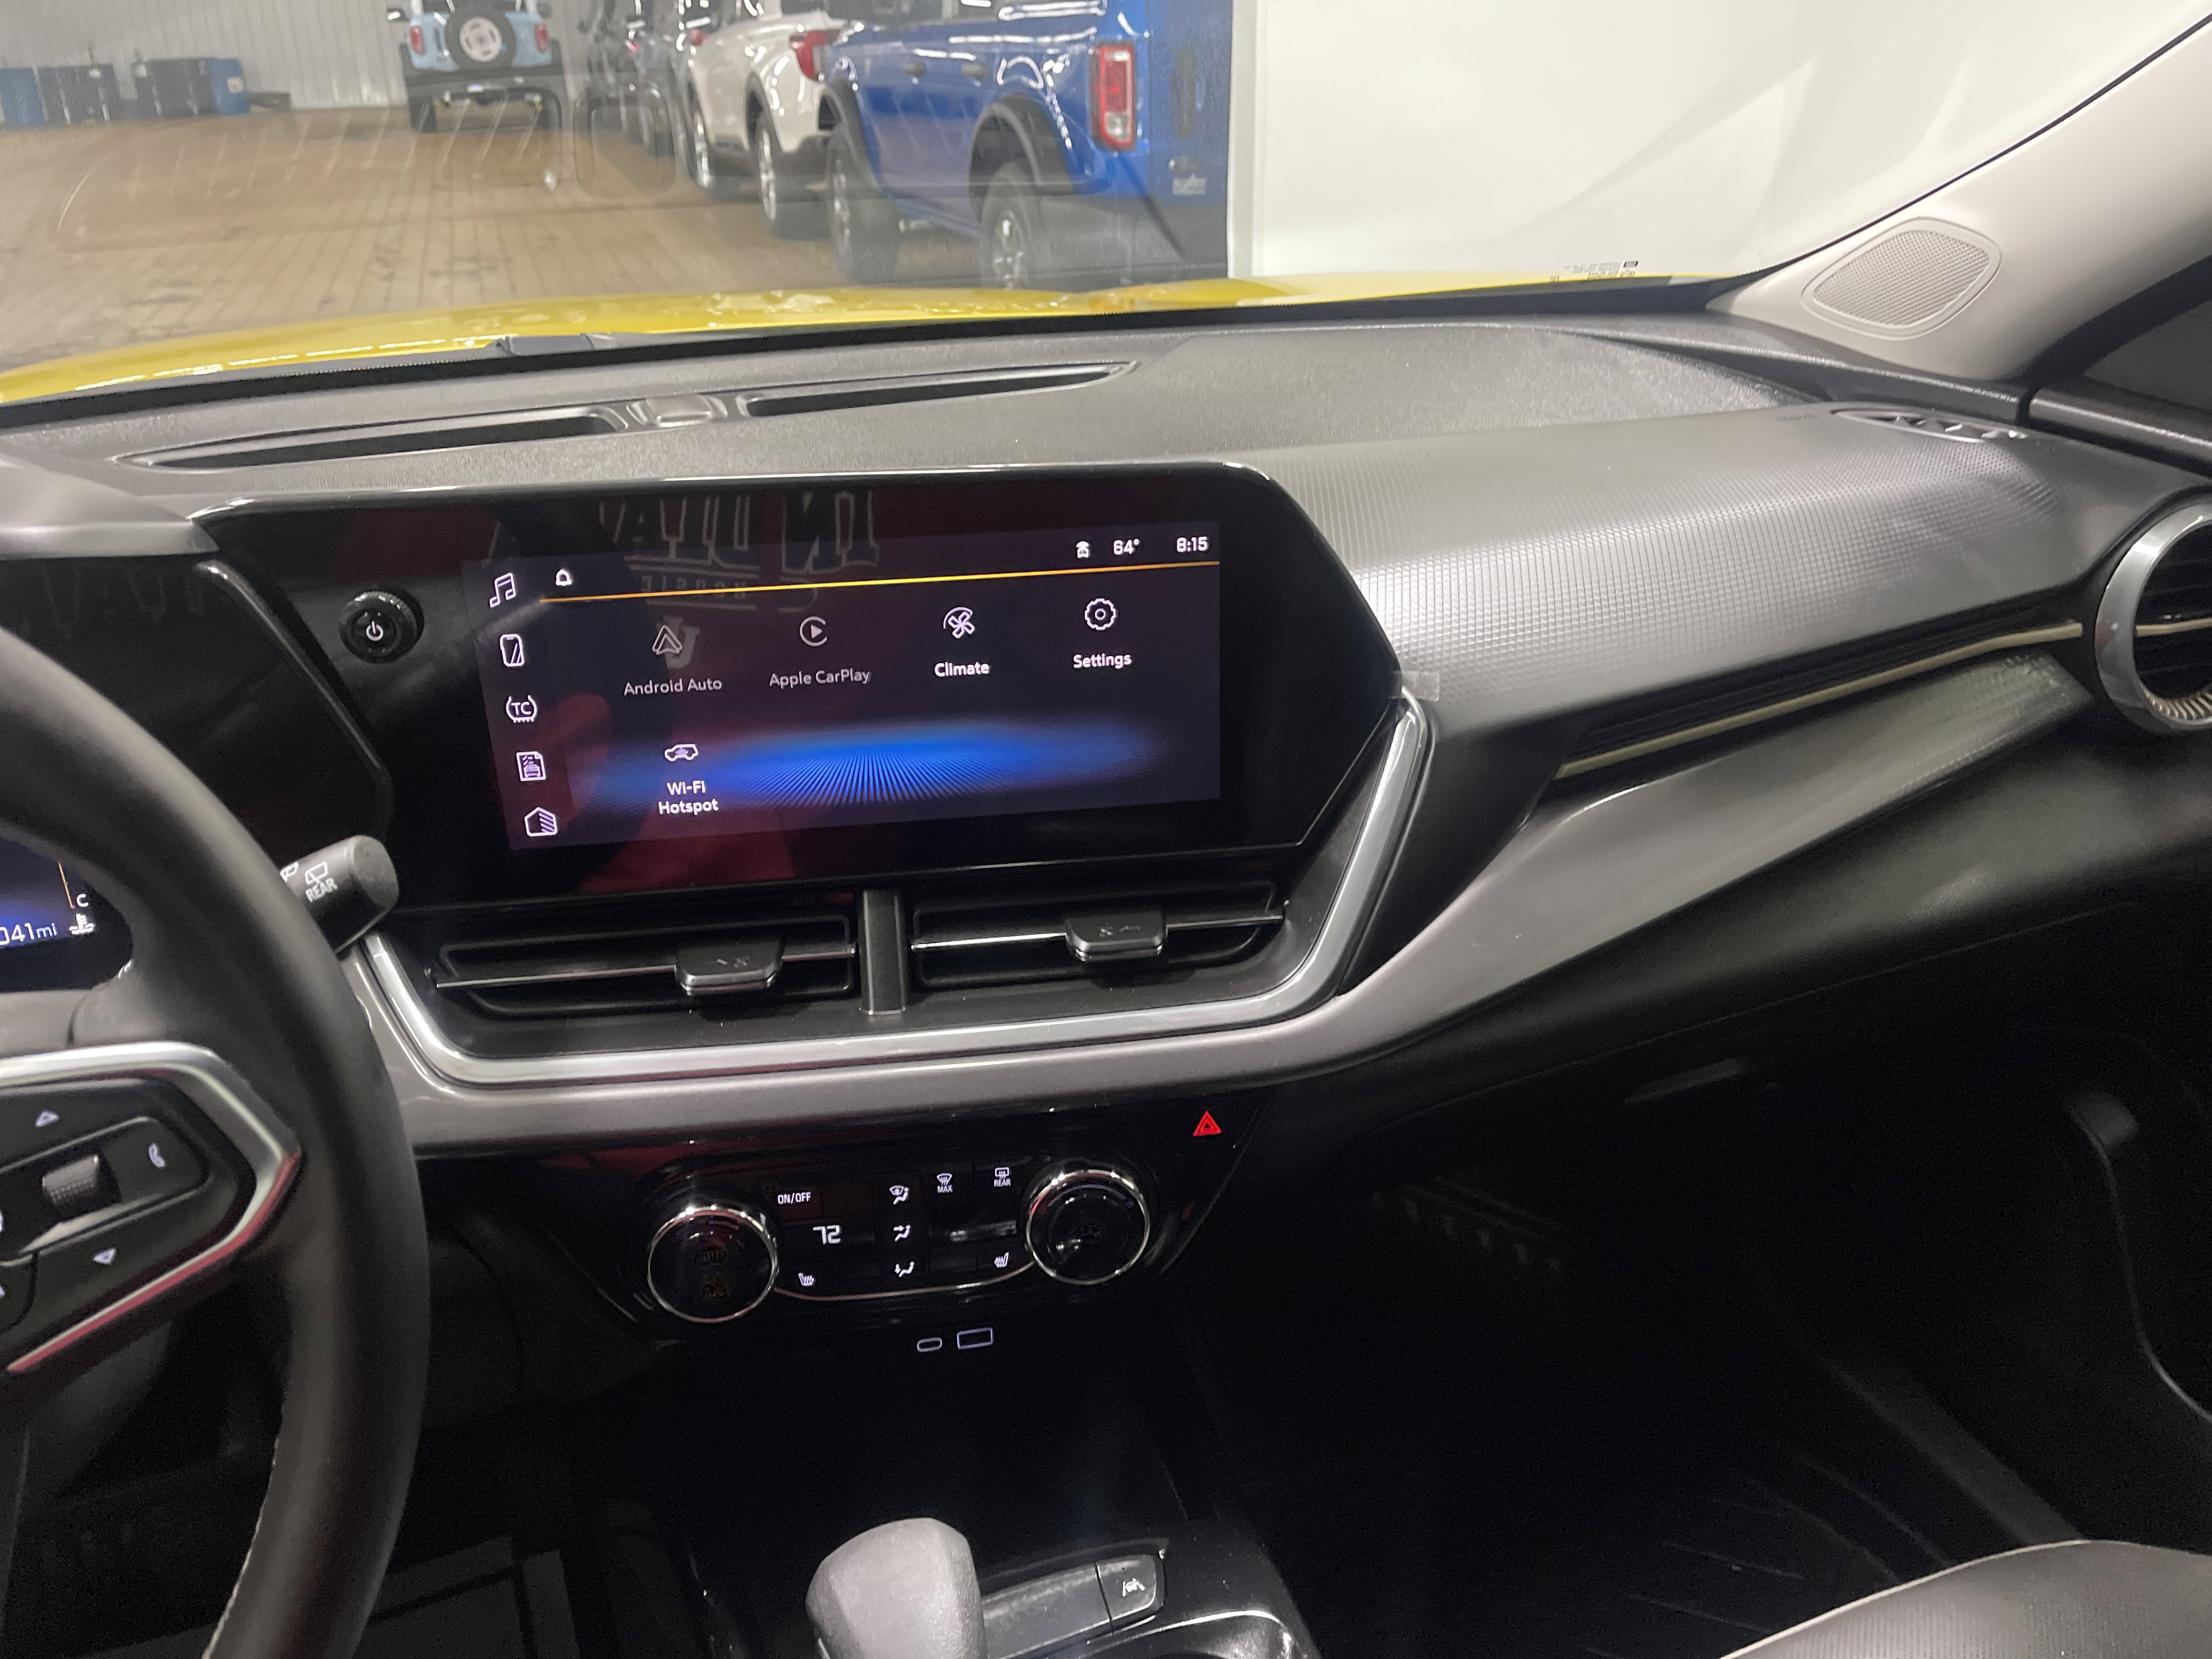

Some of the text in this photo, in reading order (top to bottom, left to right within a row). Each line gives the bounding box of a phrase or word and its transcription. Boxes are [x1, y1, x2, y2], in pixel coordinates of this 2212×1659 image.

[1176, 536, 1209, 553] 8:15
[934, 661, 990, 678] Climate
[1073, 653, 1132, 669] Settings
[769, 667, 871, 687] Apple CarPlay
[624, 678, 723, 696] Android Auto
[667, 780, 706, 796] Wi-Fi
[658, 798, 719, 816] Hotspot
[305, 877, 338, 904] REAR
[76, 893, 89, 907] C
[937, 1184, 953, 1193] MAX
[994, 1178, 1011, 1187] REAR
[777, 1192, 811, 1205] ON/OFF
[812, 1224, 841, 1245] 72
